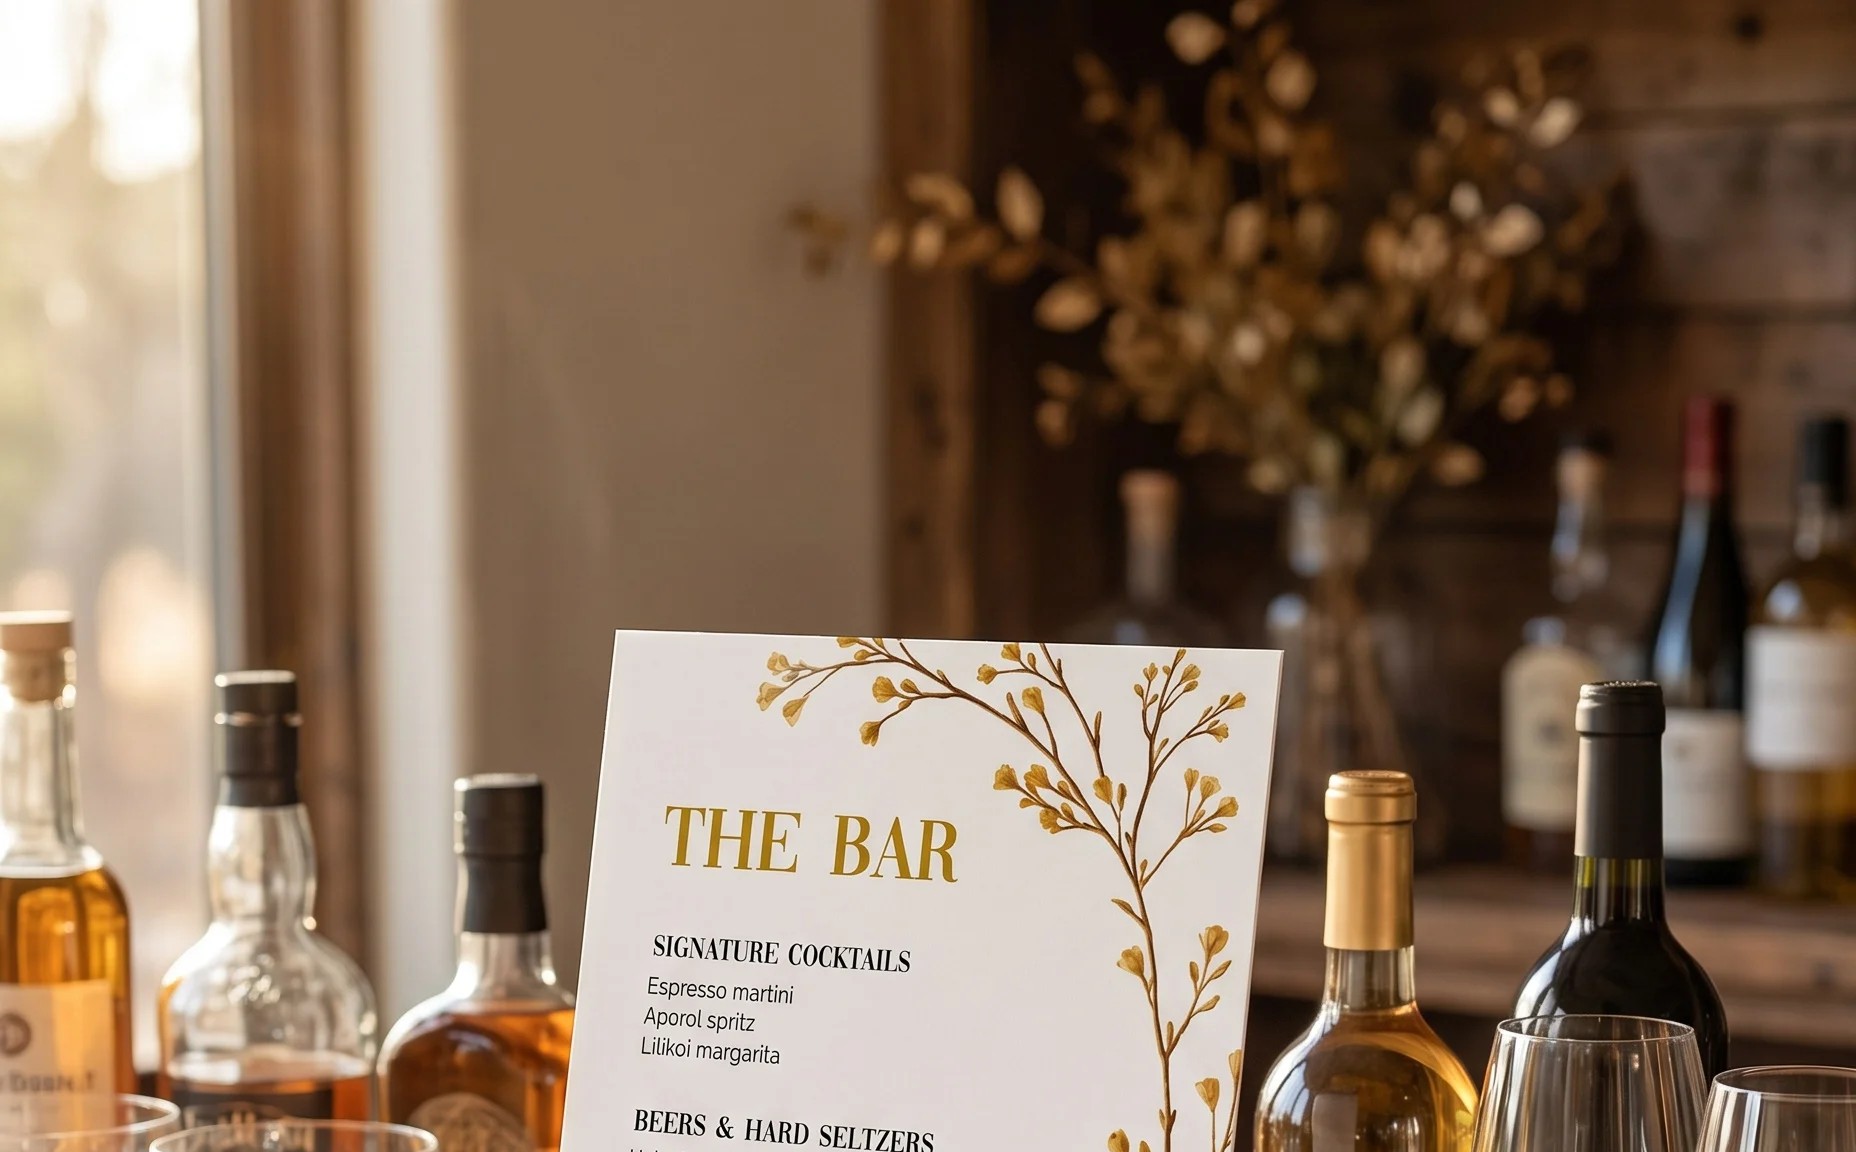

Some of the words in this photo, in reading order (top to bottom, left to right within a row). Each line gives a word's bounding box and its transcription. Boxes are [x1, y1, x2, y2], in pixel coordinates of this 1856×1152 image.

[664, 805, 802, 874] THE
[829, 814, 959, 884] BAR
[652, 934, 780, 965] SIGNATURE
[788, 942, 911, 973] COCKTAILS
[647, 976, 727, 1001] Espresso
[732, 984, 794, 1005] martini
[643, 1006, 703, 1030] Aporol
[706, 1011, 756, 1035] spritz
[641, 1036, 692, 1058] Lilikoi
[695, 1044, 780, 1067] margarita
[633, 1108, 707, 1137] BEERS
[715, 1115, 735, 1140] &
[744, 1118, 810, 1145] HARD
